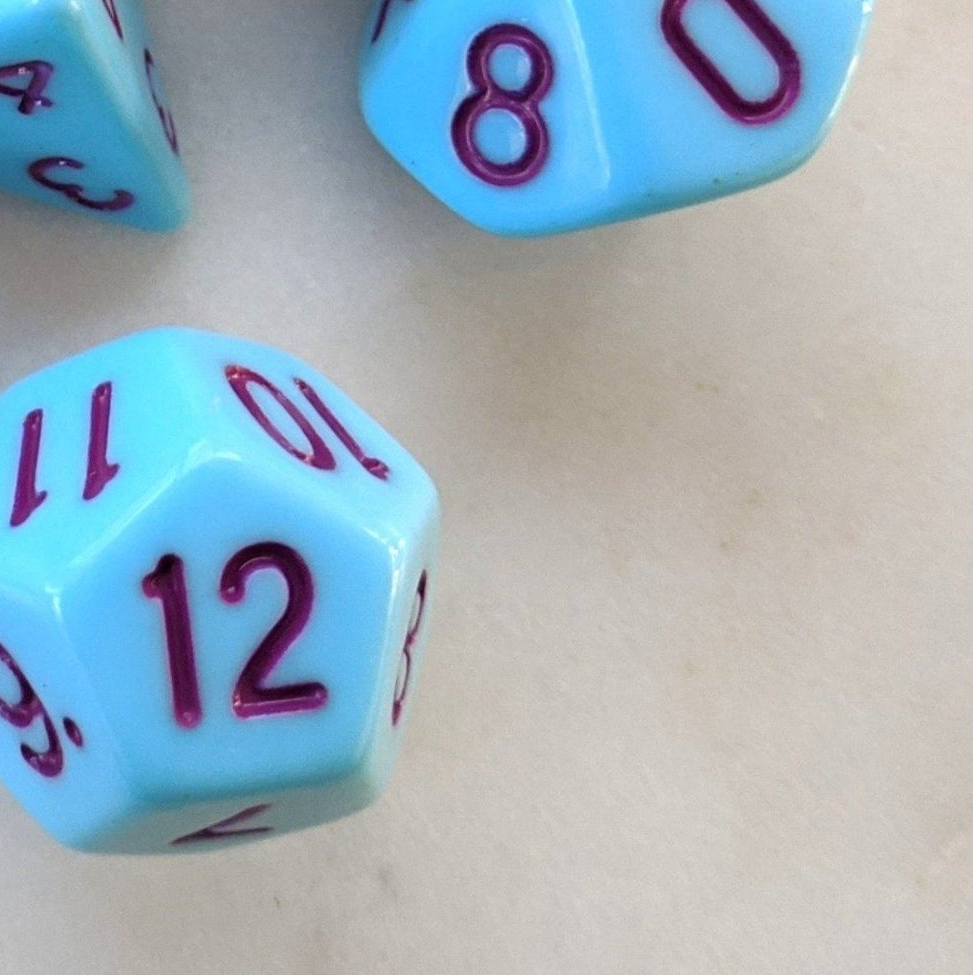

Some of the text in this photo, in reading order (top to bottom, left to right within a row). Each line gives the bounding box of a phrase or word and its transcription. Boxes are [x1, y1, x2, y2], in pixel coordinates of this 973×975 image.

[449, 23, 555, 189] 8
[27, 156, 135, 211] 3
[9, 381, 120, 527] 11
[223, 363, 393, 481] 10
[141, 540, 329, 730] 12
